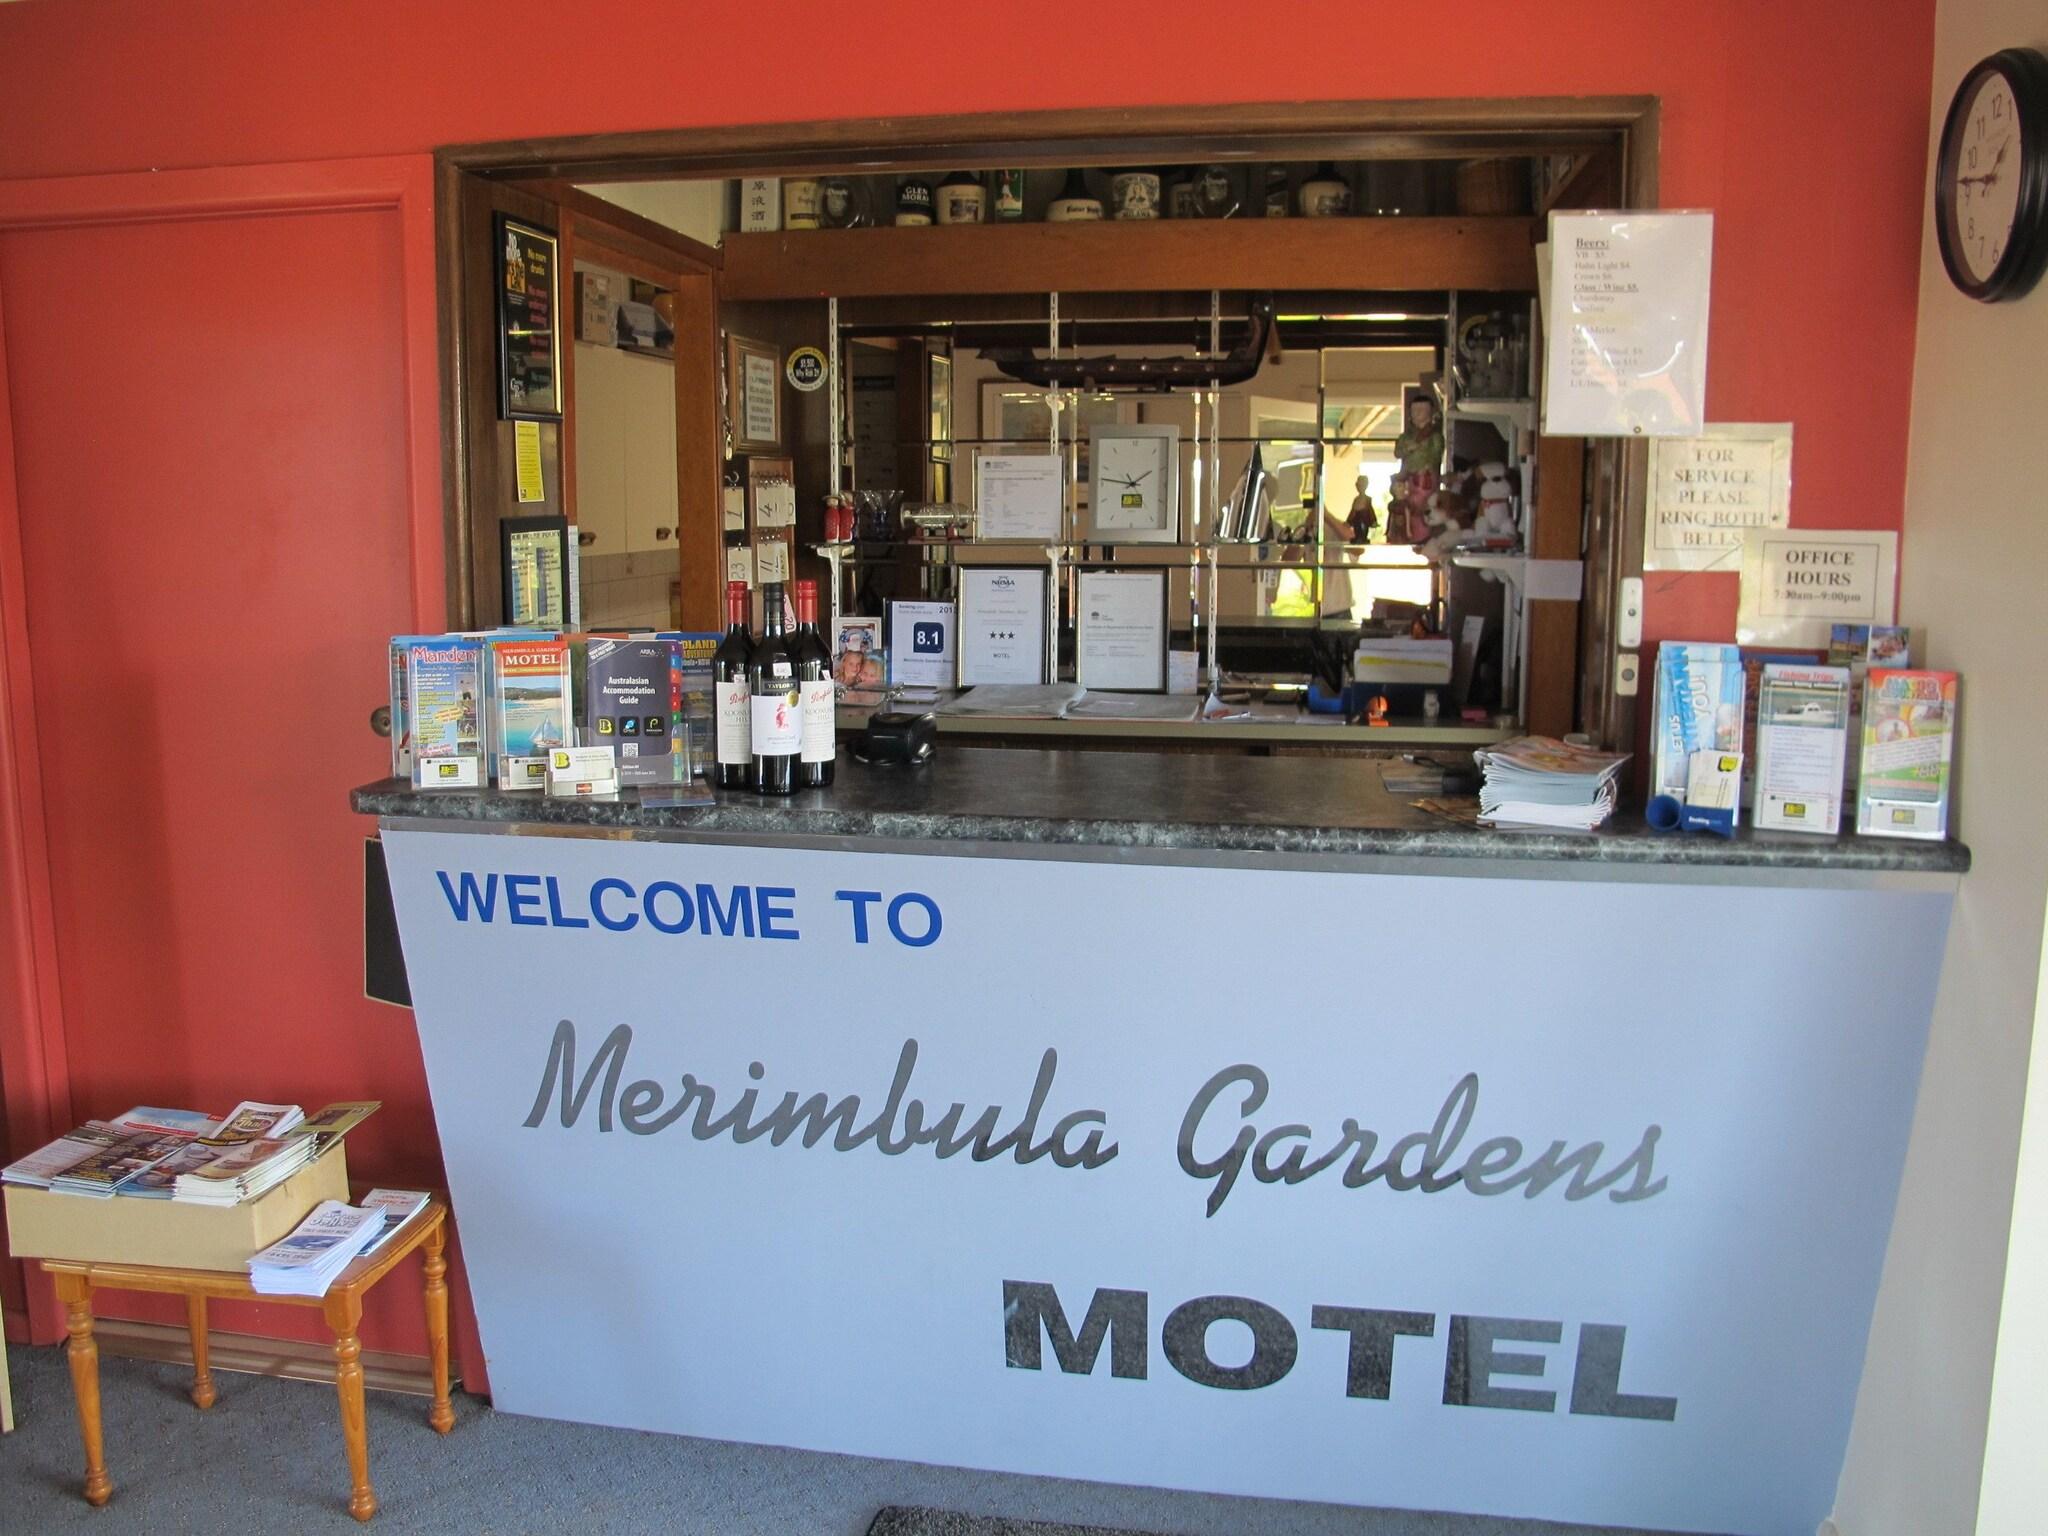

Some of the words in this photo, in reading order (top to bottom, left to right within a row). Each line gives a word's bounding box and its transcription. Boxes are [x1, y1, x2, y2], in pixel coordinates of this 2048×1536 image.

[1576, 237, 1610, 250] Beers:
[1695, 448, 1734, 463] FOR
[1674, 469, 1756, 484] SERVICE
[1679, 489, 1749, 505] PLEASE
[1660, 511, 1708, 525] RING
[1712, 511, 1765, 526] BOTH
[1785, 550, 1856, 566] OFFICE
[1786, 571, 1852, 587] HOURS
[939, 606, 956, 614] 201
[916, 631, 939, 646] 8.1
[505, 653, 560, 666] MOTEL
[608, 676, 650, 686] Australasian
[602, 686, 656, 696] Accommodation
[619, 696, 639, 705] Guide
[436, 871, 799, 939] WELCOME
[836, 890, 942, 947] TO
[522, 1019, 1118, 1170] Merimbula
[1177, 1063, 1668, 1219] Gardens
[1002, 1279, 1678, 1421] MOTEL
